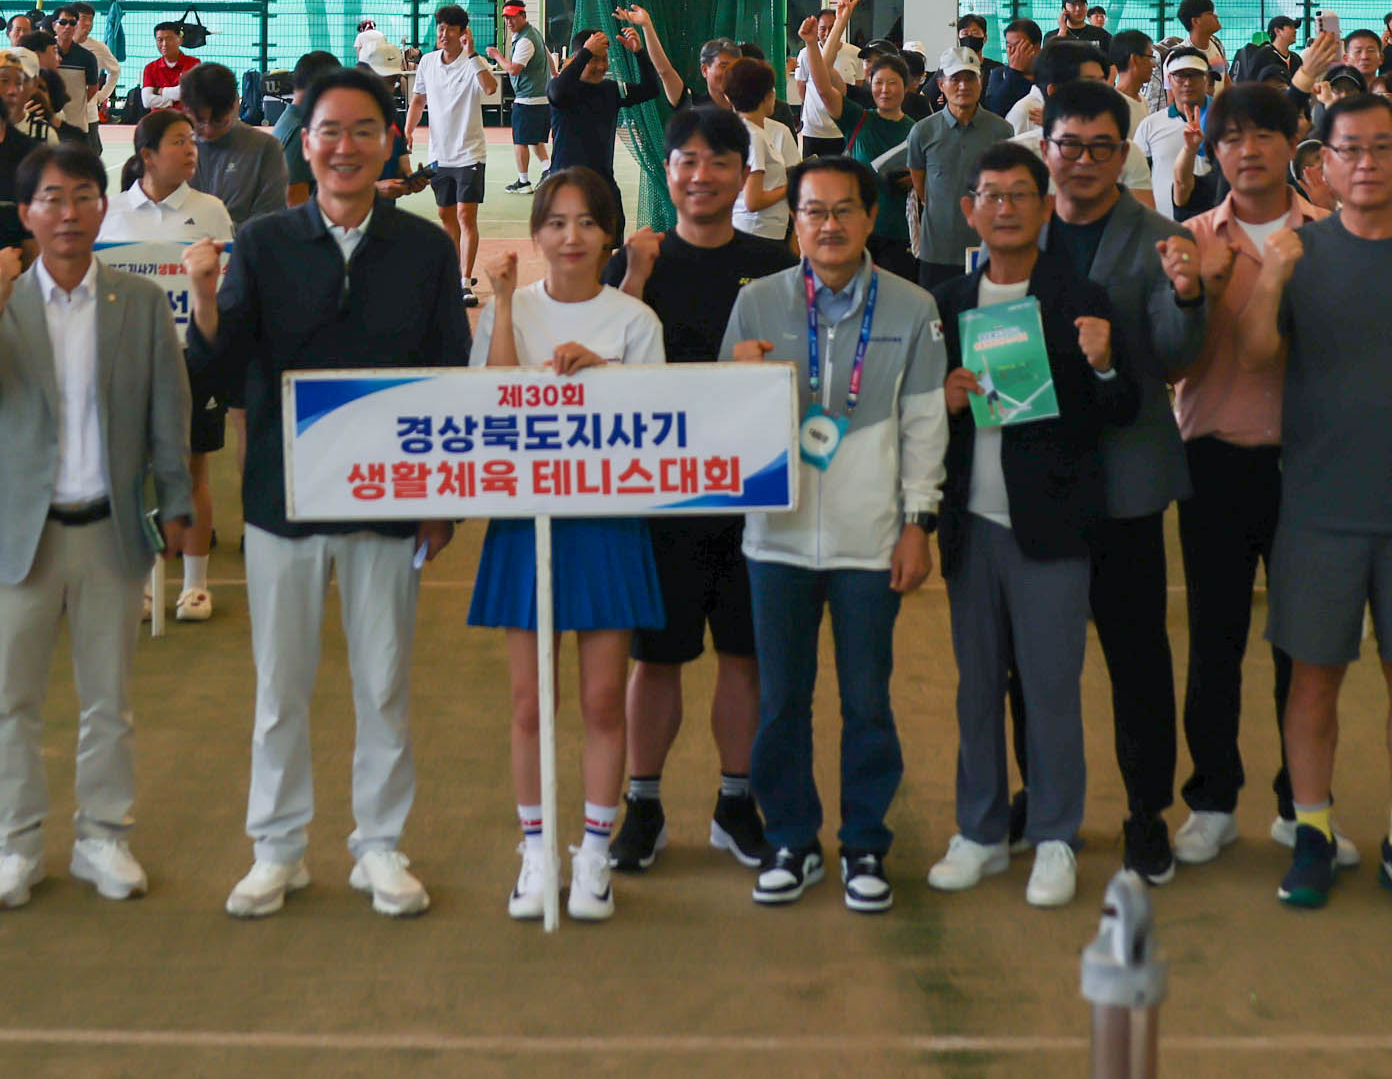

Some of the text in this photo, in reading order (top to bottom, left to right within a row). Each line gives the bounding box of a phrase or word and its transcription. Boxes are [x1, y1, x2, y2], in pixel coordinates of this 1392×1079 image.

[497, 383, 584, 408] 제30회
[396, 411, 687, 453] 경상북도지사기
[347, 455, 744, 500] 생활체육 테니스대회
